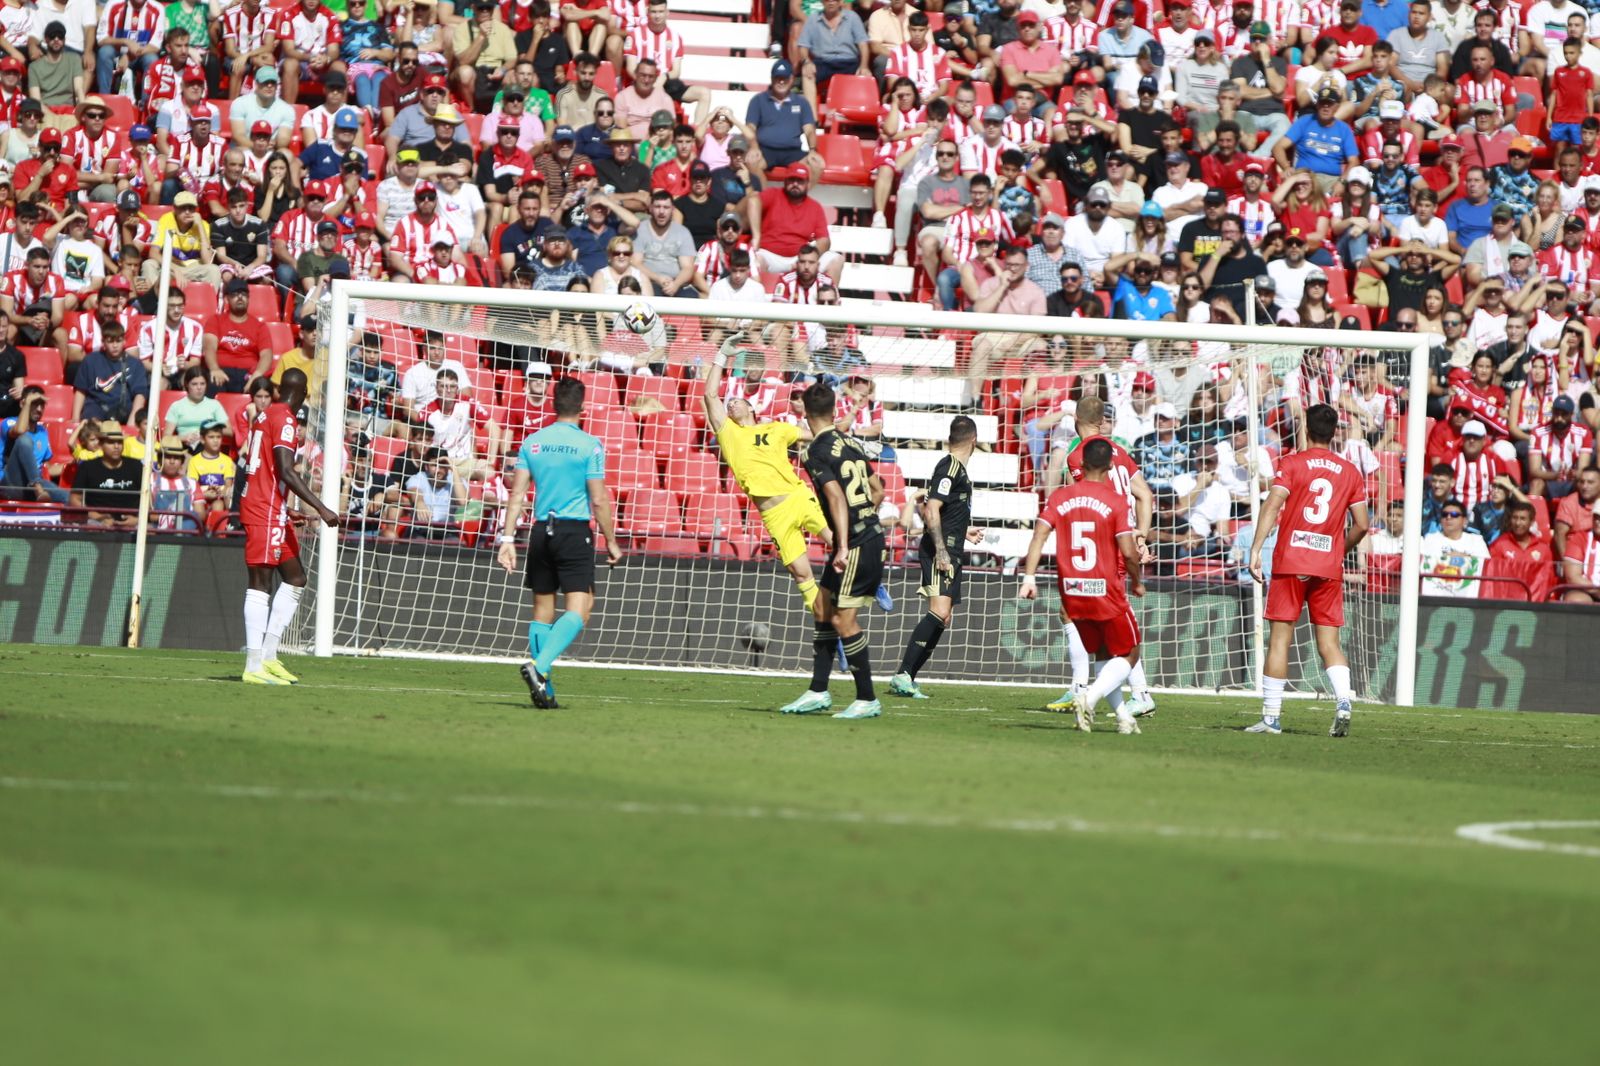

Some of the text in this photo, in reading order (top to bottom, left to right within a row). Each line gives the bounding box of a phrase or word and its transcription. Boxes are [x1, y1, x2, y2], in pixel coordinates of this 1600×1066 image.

[1306, 458, 1343, 474] MELERO
[1303, 477, 1333, 525] 3
[1056, 496, 1113, 519] ROBERTONE
[1311, 535, 1330, 543] POWER
[1071, 521, 1097, 571] 5
[1310, 541, 1329, 550] HORSE
[1083, 579, 1105, 587] POWER
[1083, 586, 1105, 594] HORSE
